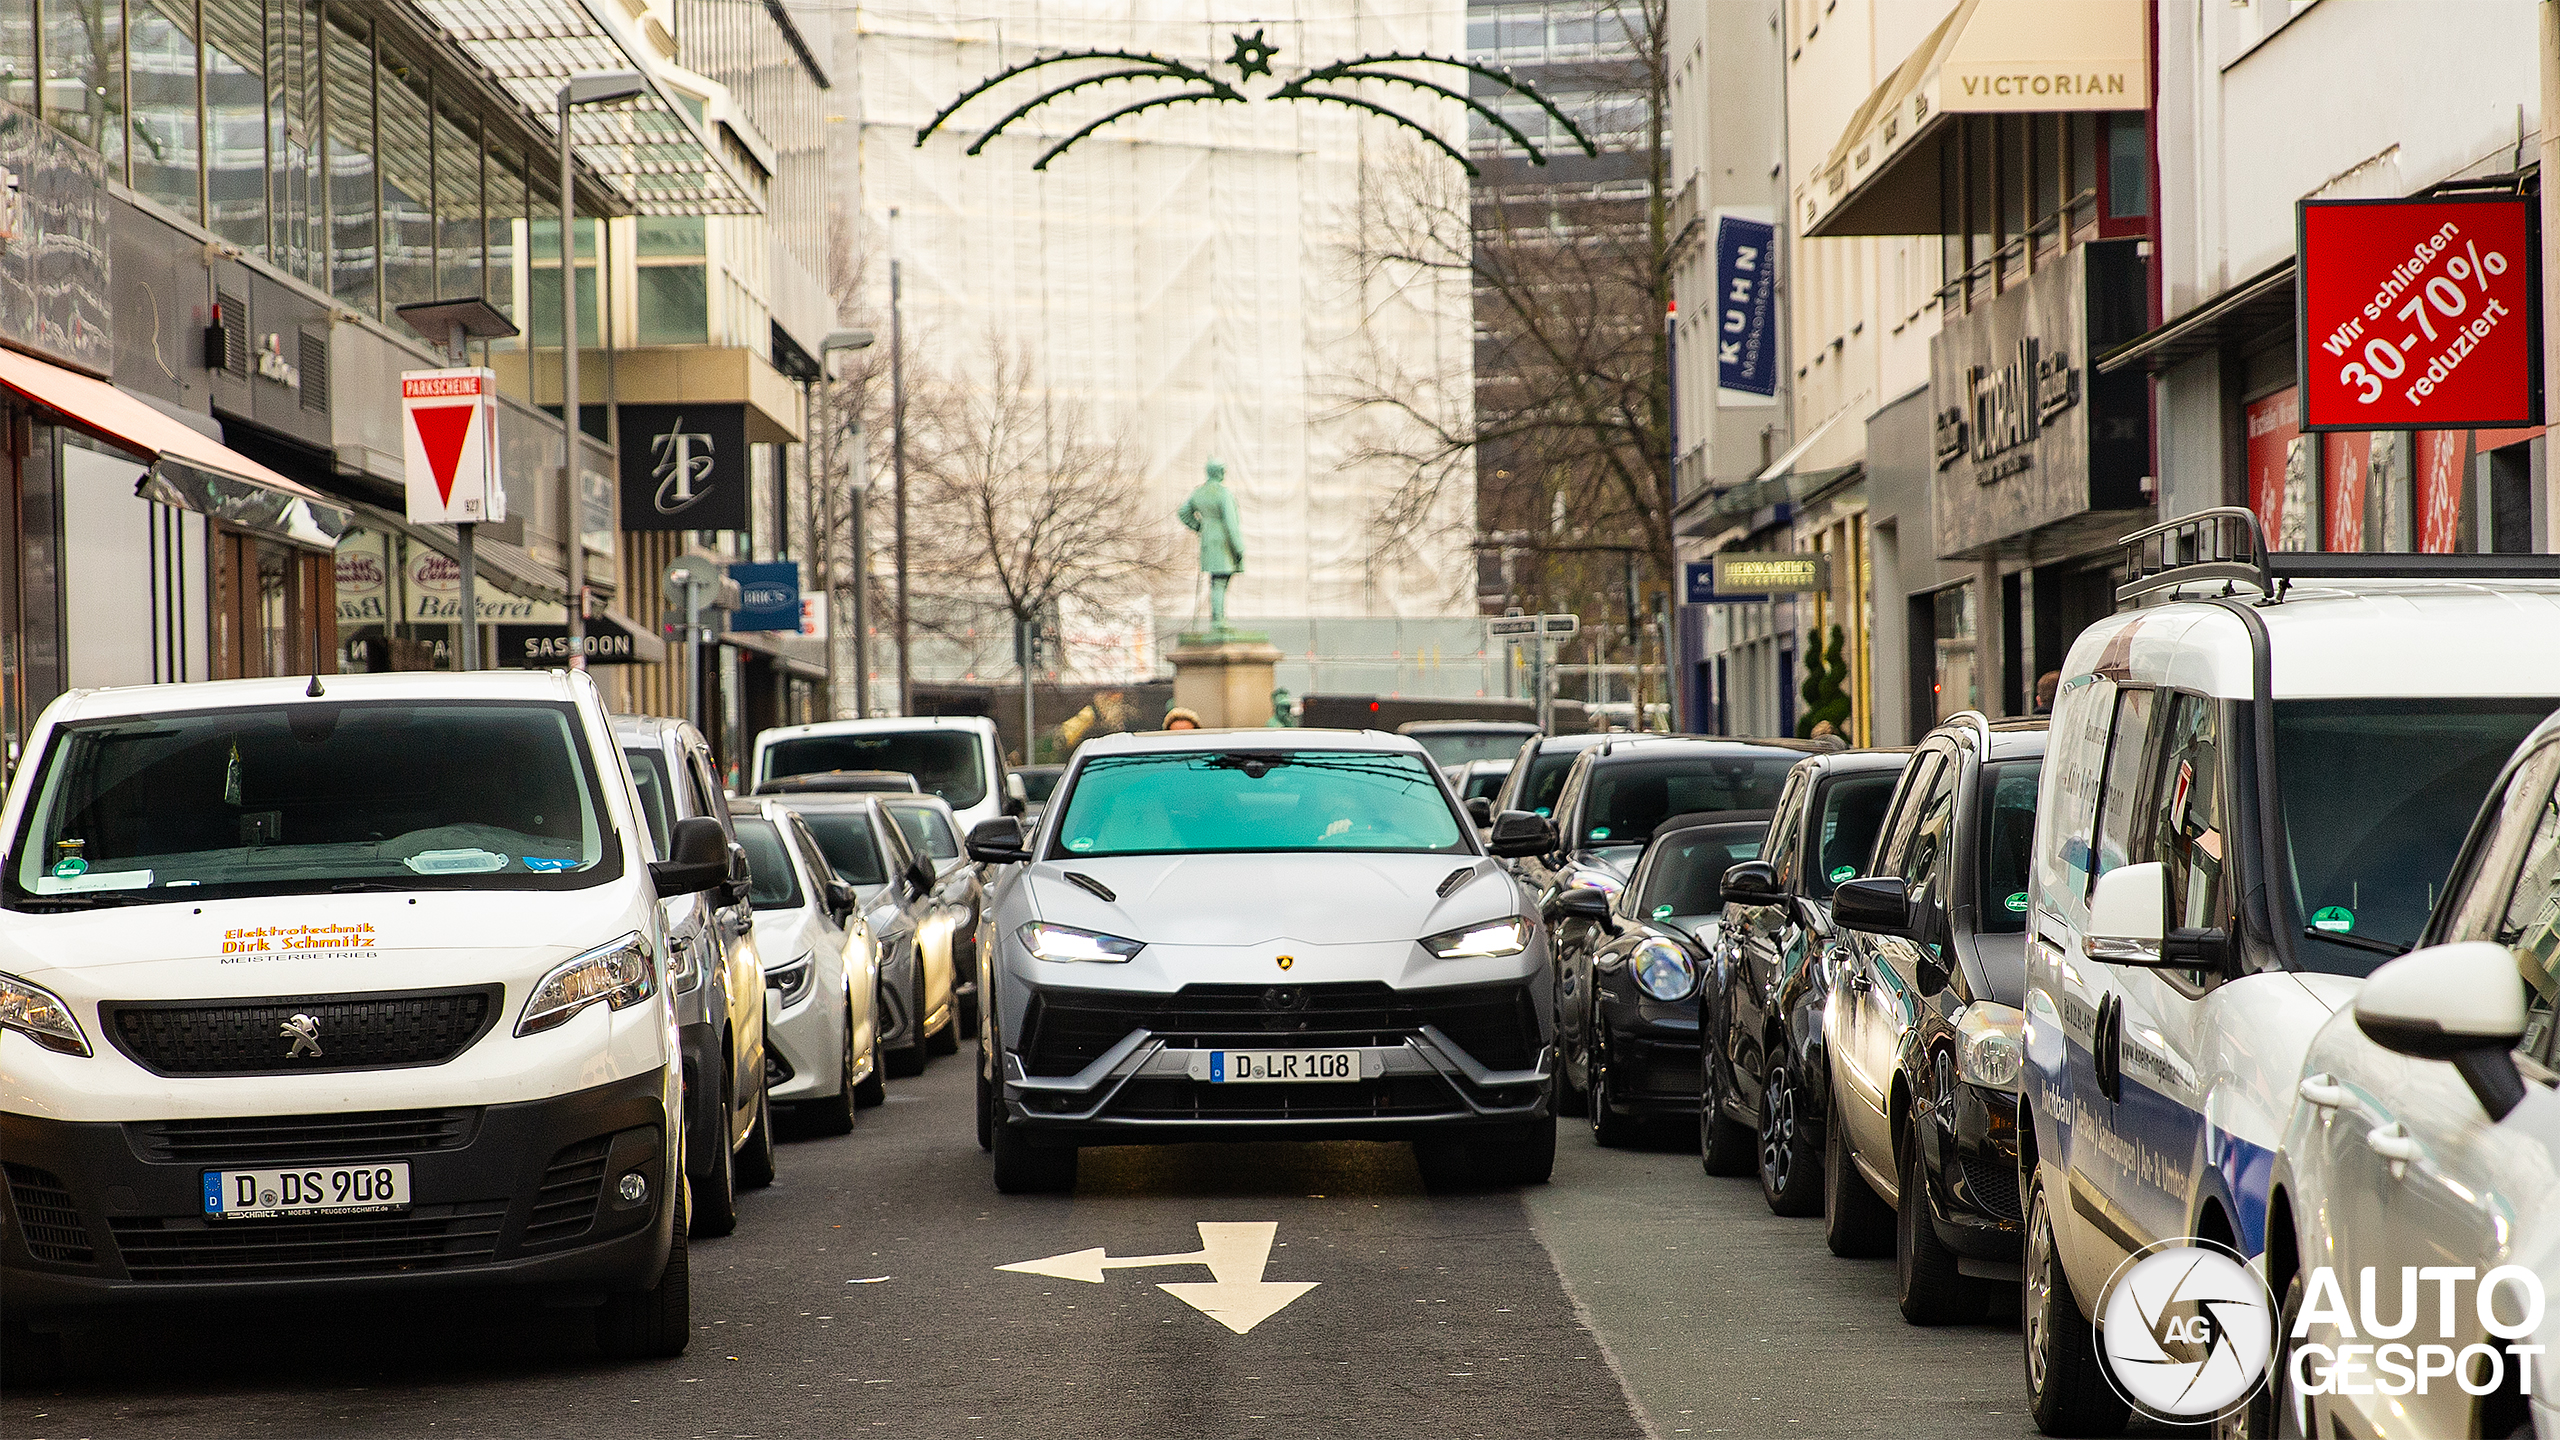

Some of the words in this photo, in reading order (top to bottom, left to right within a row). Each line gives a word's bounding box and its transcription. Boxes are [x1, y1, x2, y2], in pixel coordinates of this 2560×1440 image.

[1961, 74, 2125, 95] VICTORIAN
[2322, 316, 2365, 357] Wir
[2363, 221, 2460, 321] schließen
[1719, 245, 1759, 364] KUHN
[2339, 238, 2508, 405] 30-70%
[2405, 298, 2509, 406] reduziert
[406, 378, 478, 396] PARKSCHEINE
[525, 635, 630, 658] SASOON
[2327, 907, 2339, 921] 4
[224, 922, 376, 939] Elektrotechnik
[222, 938, 271, 954] Dirk
[281, 934, 376, 950] Schmitz
[220, 951, 378, 965] MEISTERBETRIEB
[1236, 1055, 1250, 1078] D
[1267, 1055, 1298, 1078] LR
[1305, 1054, 1349, 1078] 108
[235, 1175, 257, 1207] D
[280, 1171, 324, 1205] DS
[331, 1168, 394, 1202] 908
[288, 1208, 311, 1216] MOERS
[320, 1205, 389, 1215] PEUGEOT-SCHMITZ.de
